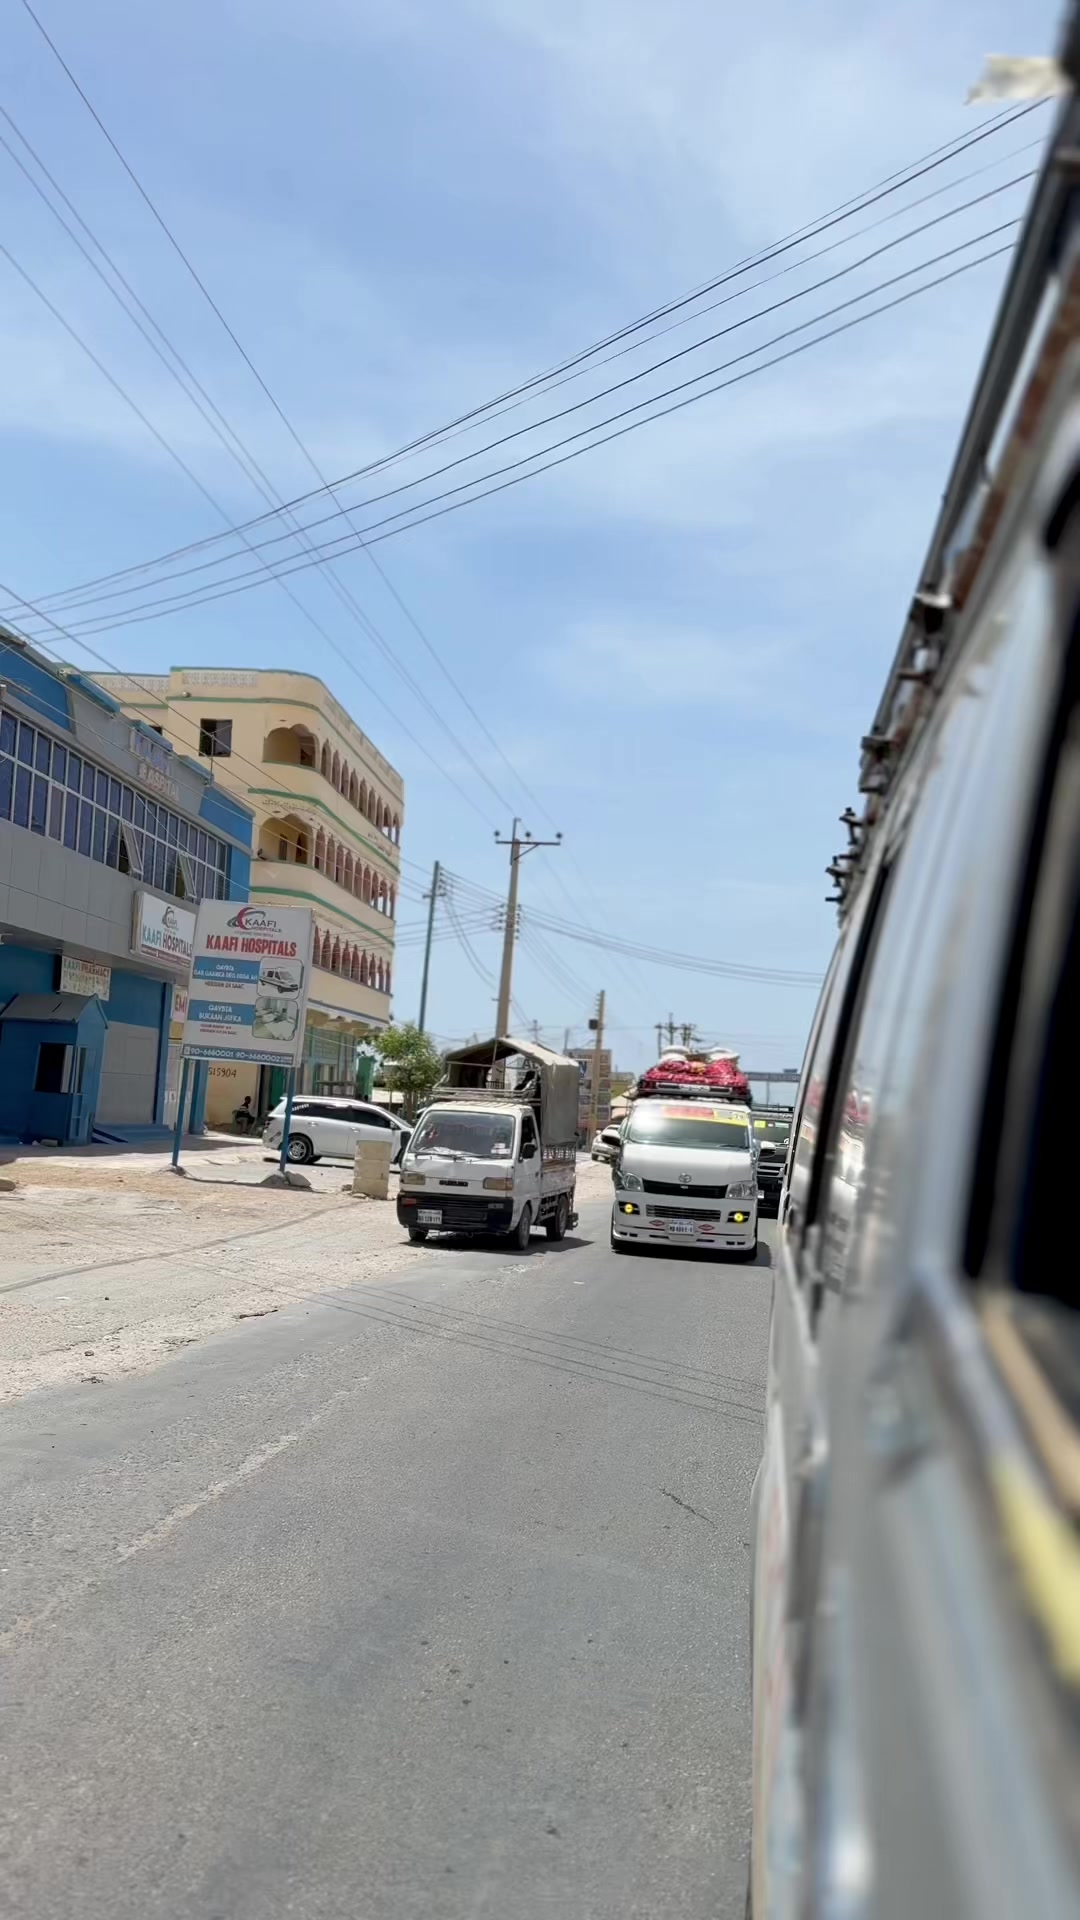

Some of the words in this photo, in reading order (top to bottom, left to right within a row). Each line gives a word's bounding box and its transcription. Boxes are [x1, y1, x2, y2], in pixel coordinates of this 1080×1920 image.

[245, 918, 277, 928] KAAFI
[143, 925, 162, 948] KAAFI
[163, 931, 193, 958] HOSPITALS
[206, 934, 239, 952] KAAFI
[241, 937, 297, 957] HOSPITALS
